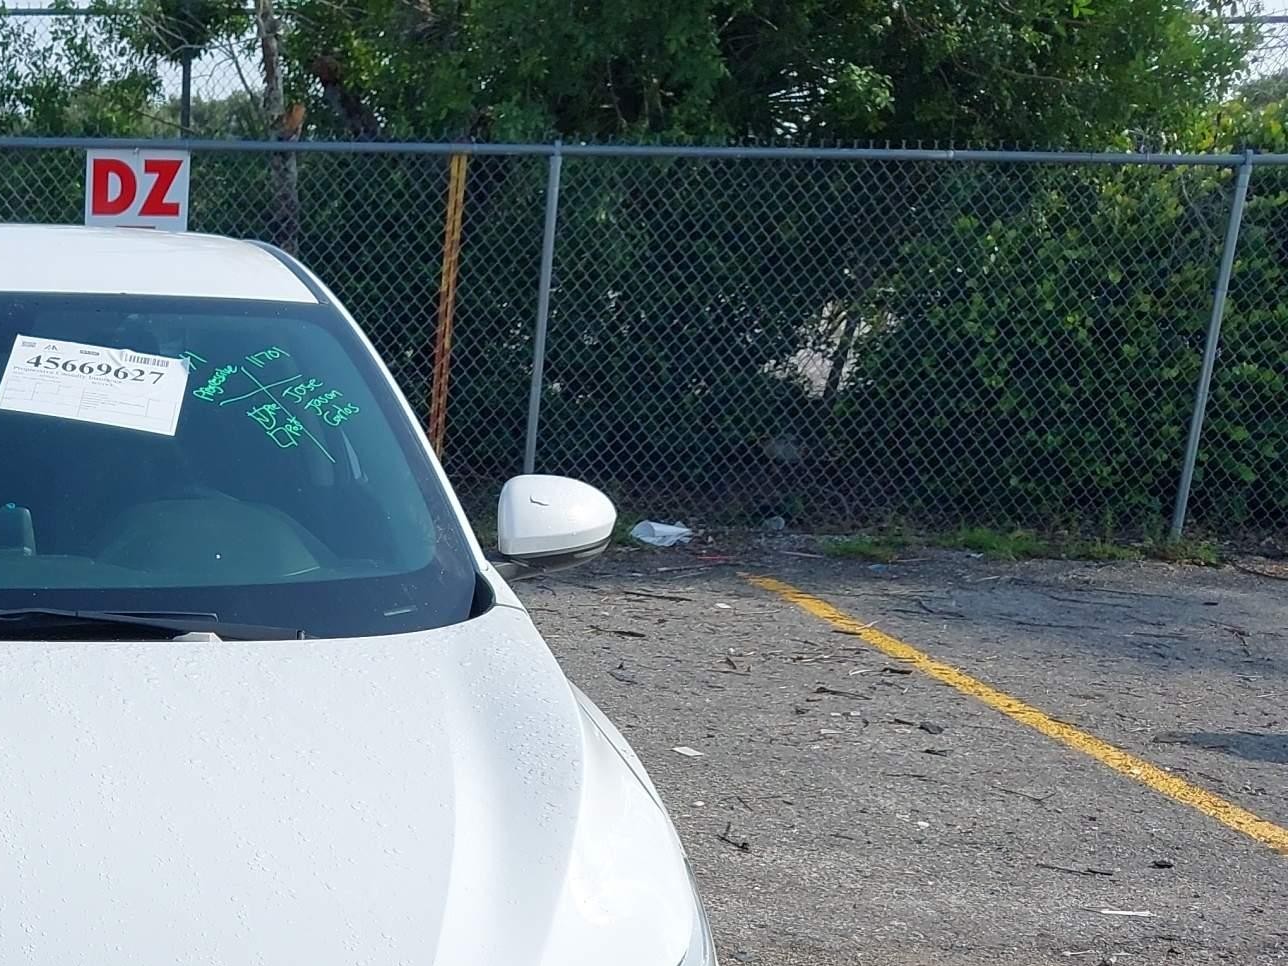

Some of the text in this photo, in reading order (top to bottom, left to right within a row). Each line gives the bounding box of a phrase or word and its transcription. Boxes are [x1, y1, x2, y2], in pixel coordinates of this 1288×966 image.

[92, 158, 184, 216] DZ
[26, 354, 165, 385] 45669627
[245, 346, 291, 369] 11701
[281, 378, 324, 404] Jose
[303, 390, 344, 416] Jason
